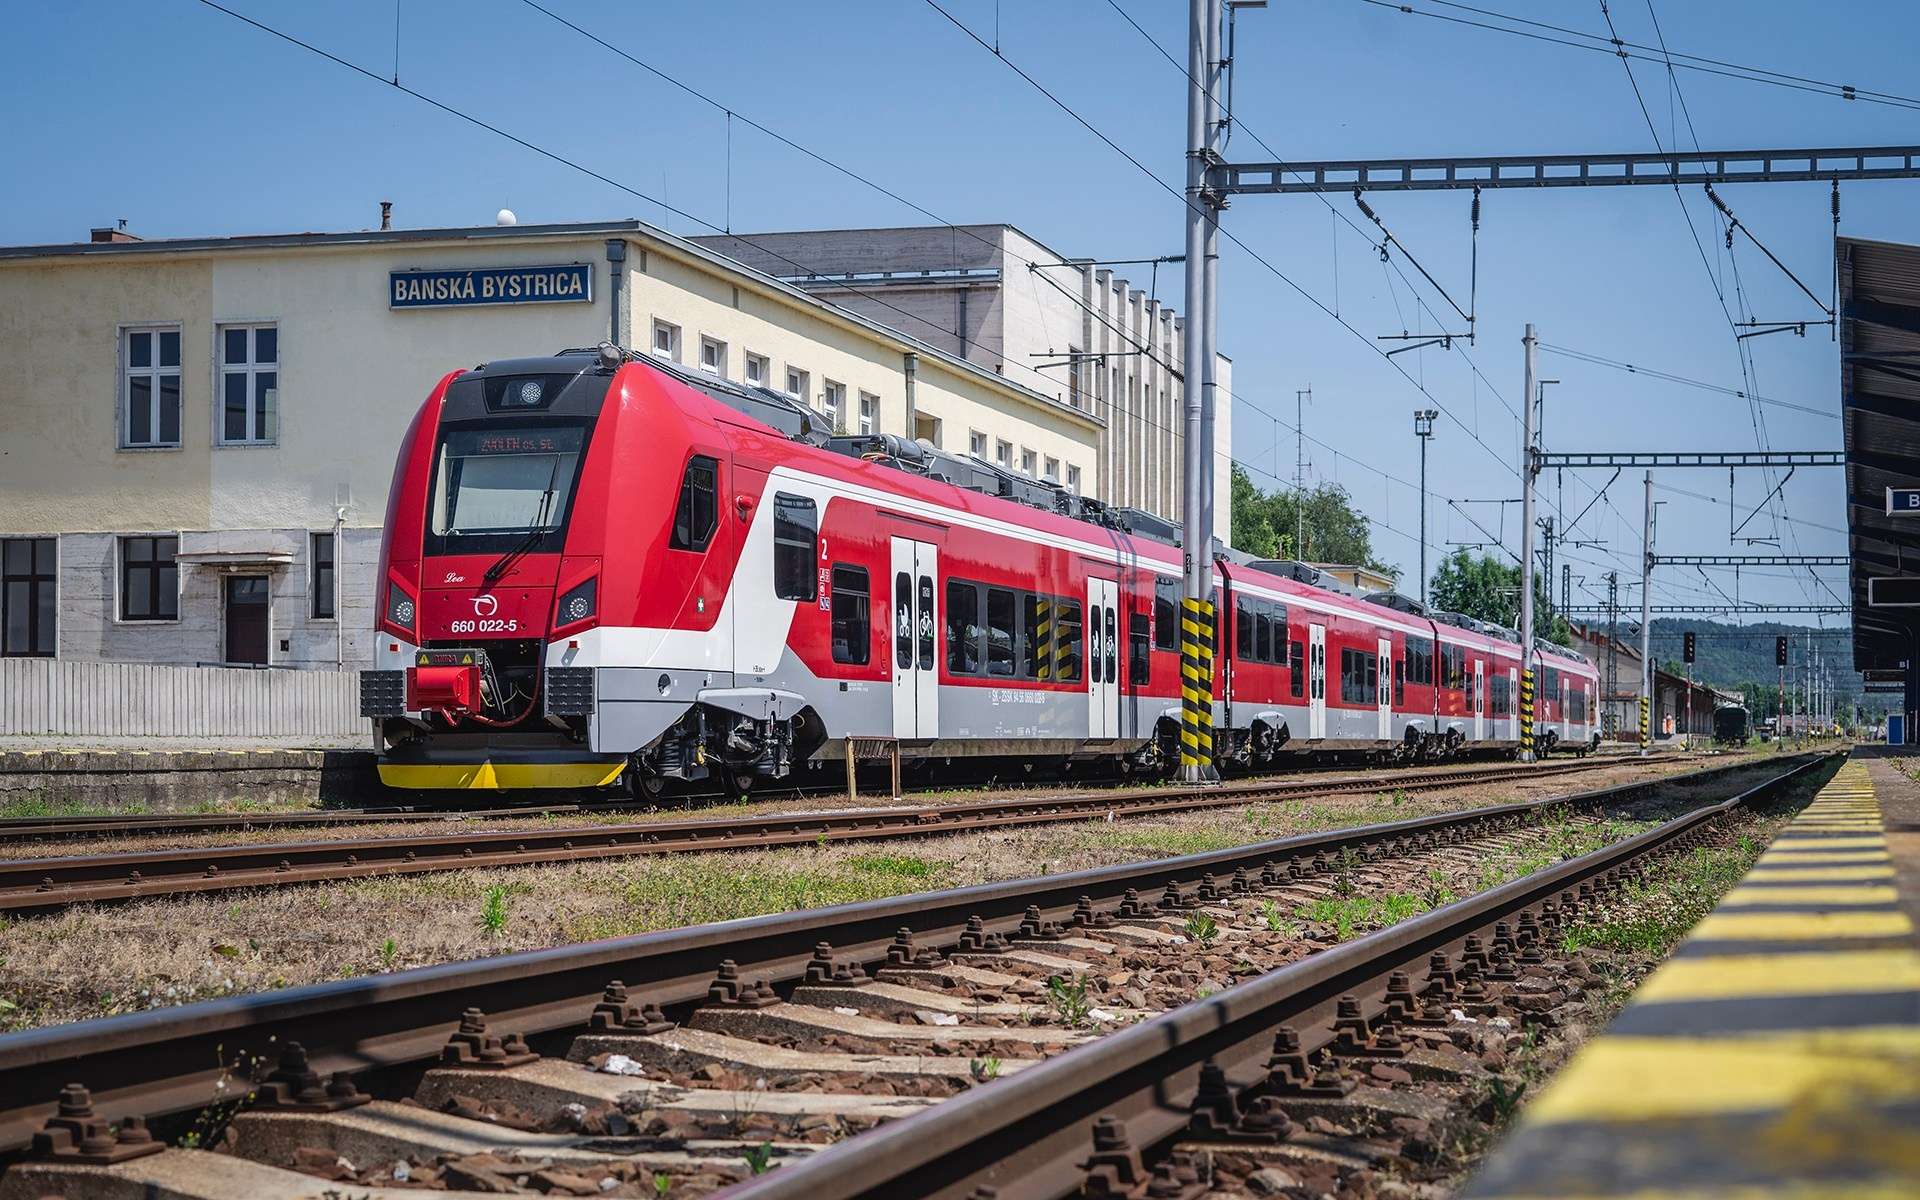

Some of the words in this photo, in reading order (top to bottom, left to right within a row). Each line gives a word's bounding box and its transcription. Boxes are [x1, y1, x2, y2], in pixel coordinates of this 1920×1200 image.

[395, 272, 476, 301] BANSKÁ
[482, 272, 583, 298] BYSTRICA
[821, 538, 828, 560] 2
[444, 572, 465, 583] Lea
[451, 620, 476, 633] 660
[479, 619, 518, 632] 022-5
